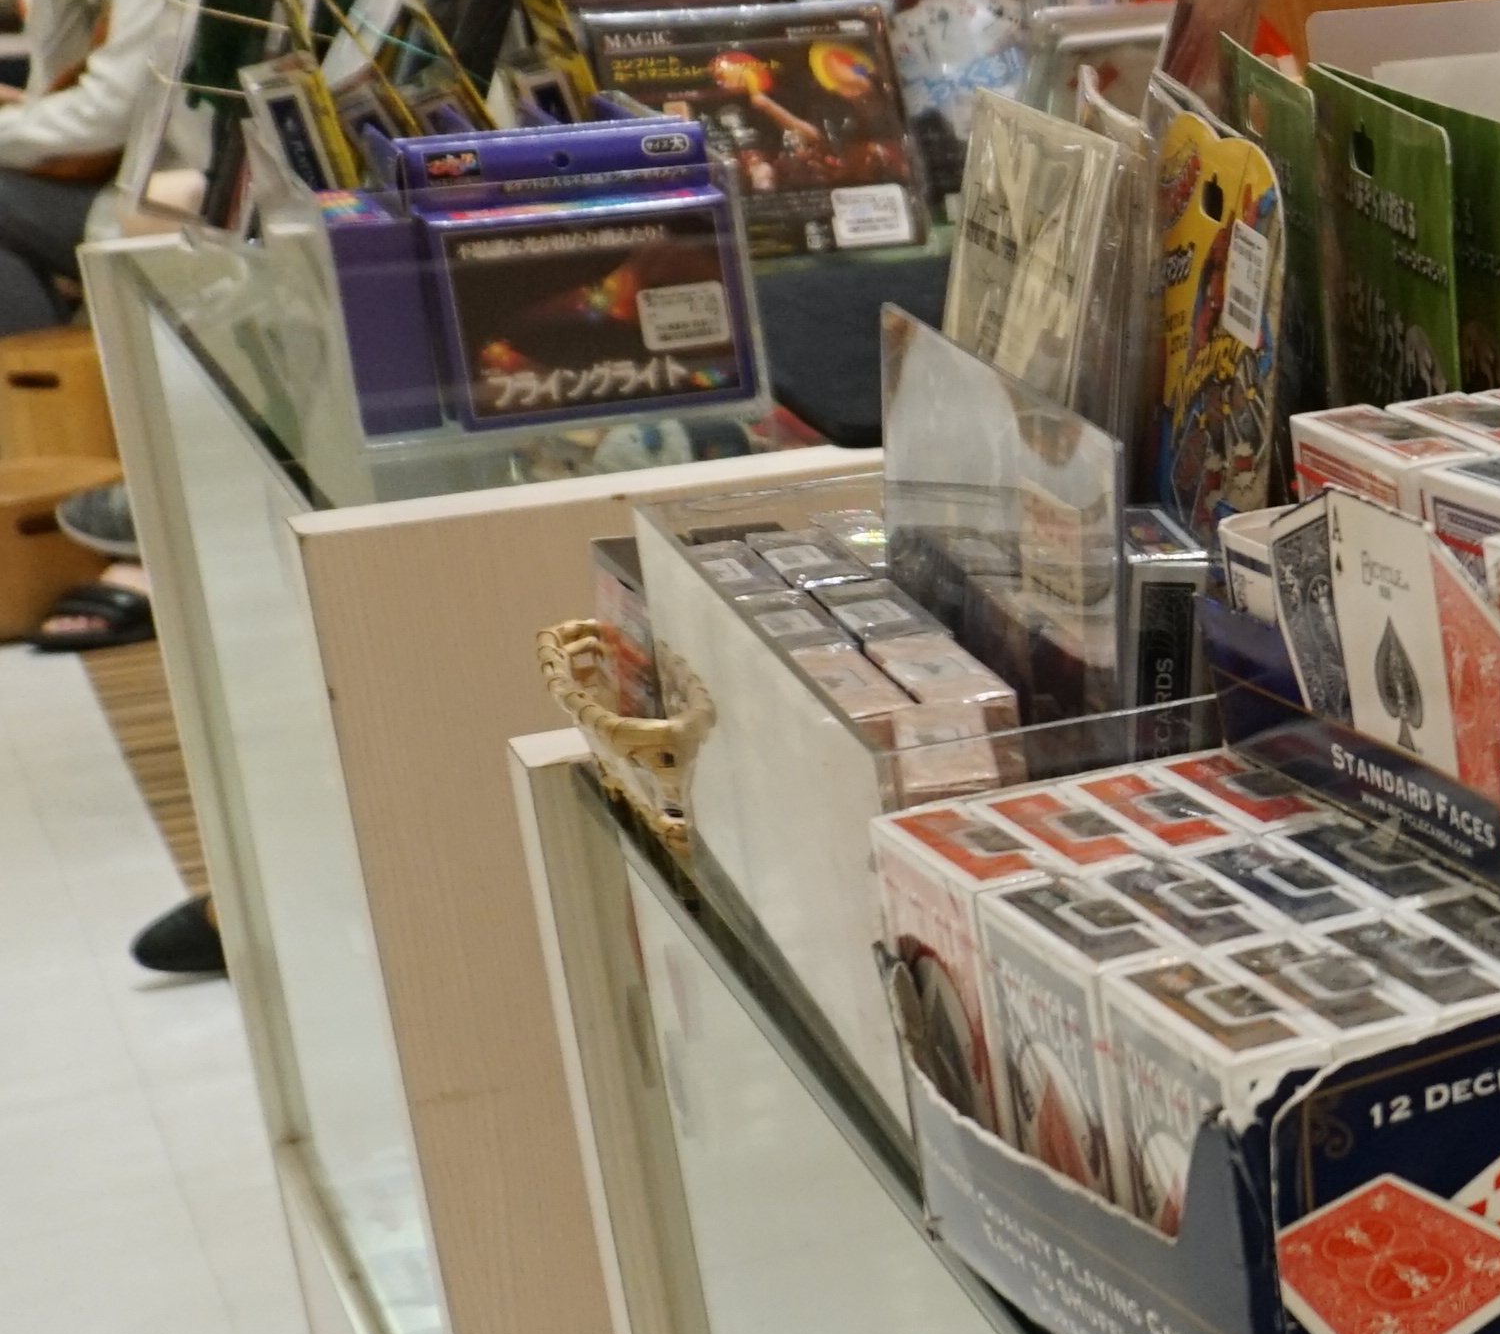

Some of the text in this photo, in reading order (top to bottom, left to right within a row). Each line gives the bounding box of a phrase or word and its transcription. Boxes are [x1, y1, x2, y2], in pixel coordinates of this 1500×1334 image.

[605, 30, 671, 53] MAGIC
[487, 354, 689, 410] フライングライト
[1330, 743, 1497, 849] STANDARD FACES
[1369, 1096, 1414, 1130] 12
[1055, 1245, 1144, 1327] PLAYING
